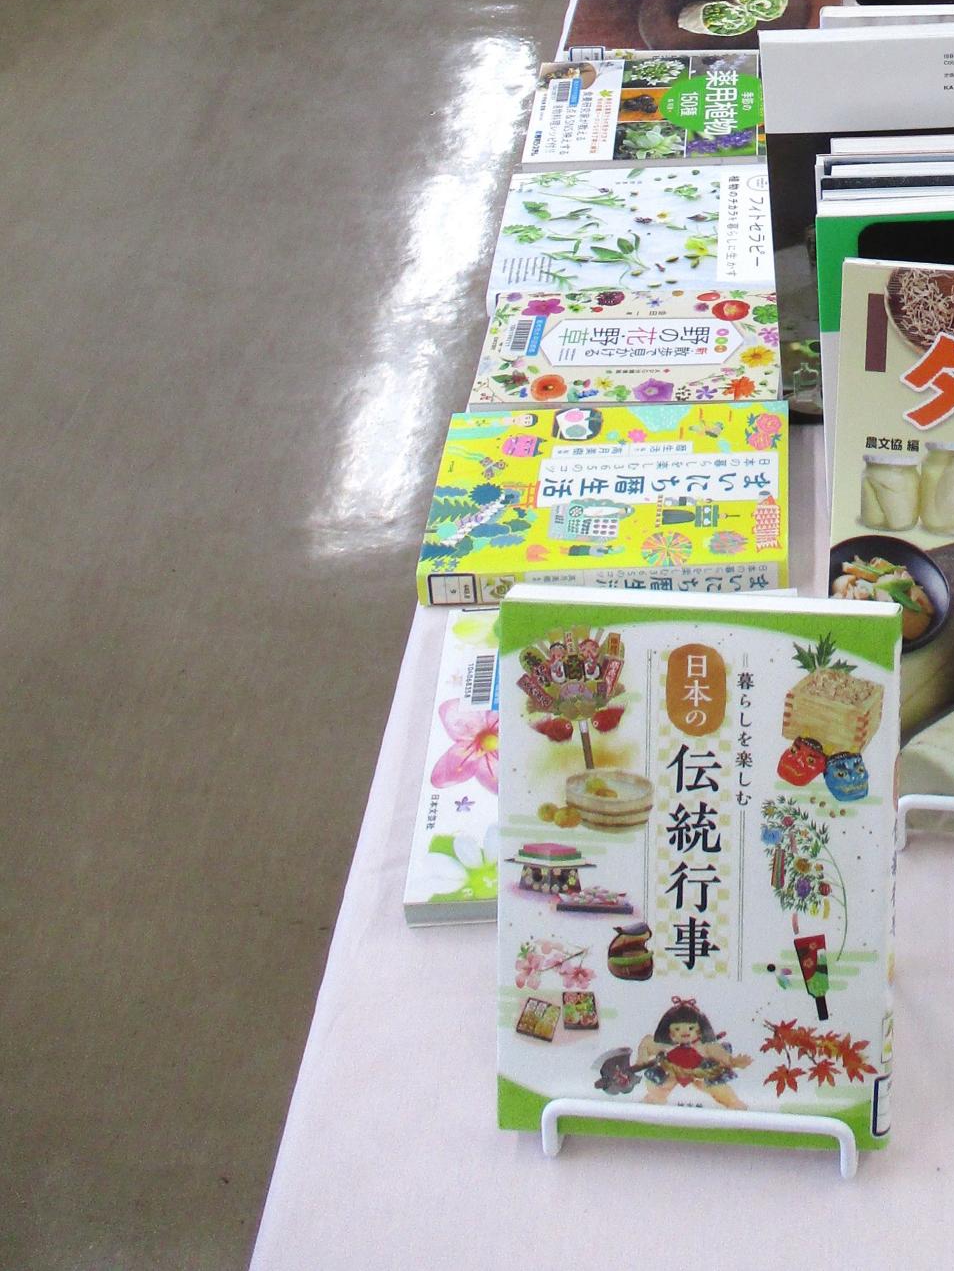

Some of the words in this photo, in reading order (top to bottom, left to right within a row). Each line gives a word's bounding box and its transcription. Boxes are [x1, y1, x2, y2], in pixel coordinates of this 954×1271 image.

[679, 91, 700, 117] 150種
[704, 69, 739, 135] 薬用植物
[749, 196, 766, 267] フィトセラピー
[558, 325, 711, 347] 野の花・野草
[865, 437, 903, 451] 農文協
[907, 439, 920, 452] 編
[542, 472, 771, 498] まいにち暦生活
[682, 654, 713, 729] 日本の
[734, 670, 756, 808] 暮らしを楽しむ
[664, 742, 723, 971] 伝統行事
